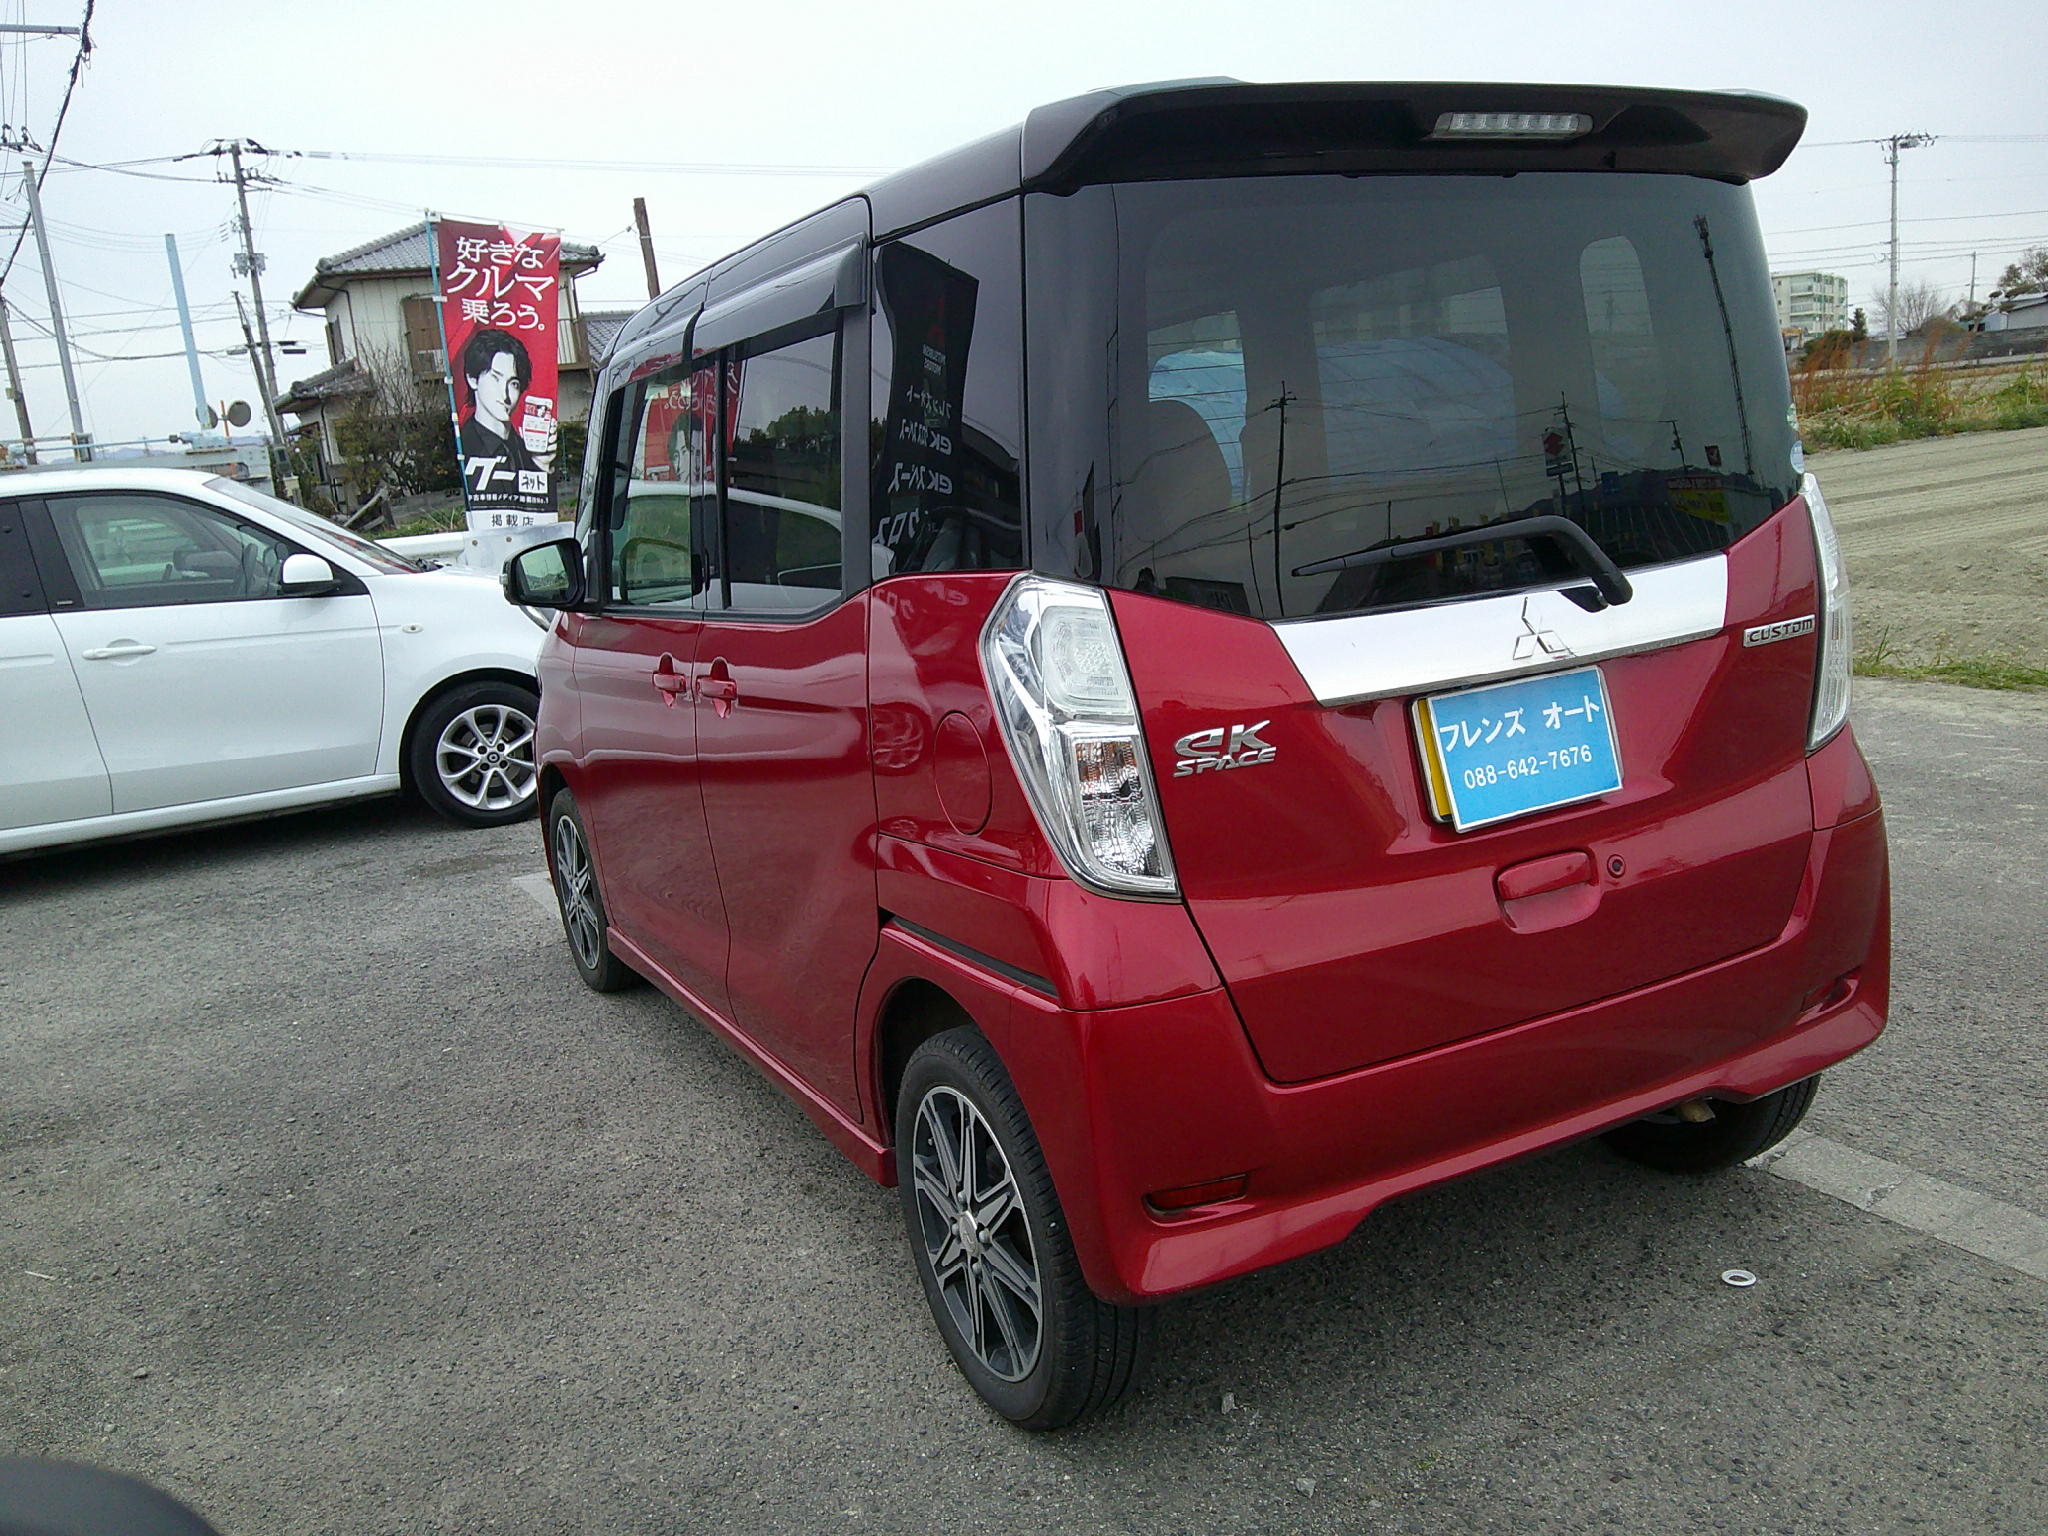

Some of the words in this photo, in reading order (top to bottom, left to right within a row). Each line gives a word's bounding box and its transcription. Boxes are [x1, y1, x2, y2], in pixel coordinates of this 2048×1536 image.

[456, 236, 544, 269] 好きな
[446, 261, 555, 301] クルマ
[461, 298, 545, 331] 乗ろう。
[491, 513, 535, 528] 掲載店
[1748, 618, 1814, 643] CUSTOM
[1439, 707, 1527, 753] フレンズ
[1542, 695, 1600, 730] オート
[1172, 746, 1277, 778] SPACE
[1463, 744, 1593, 790] 088-642-7676
